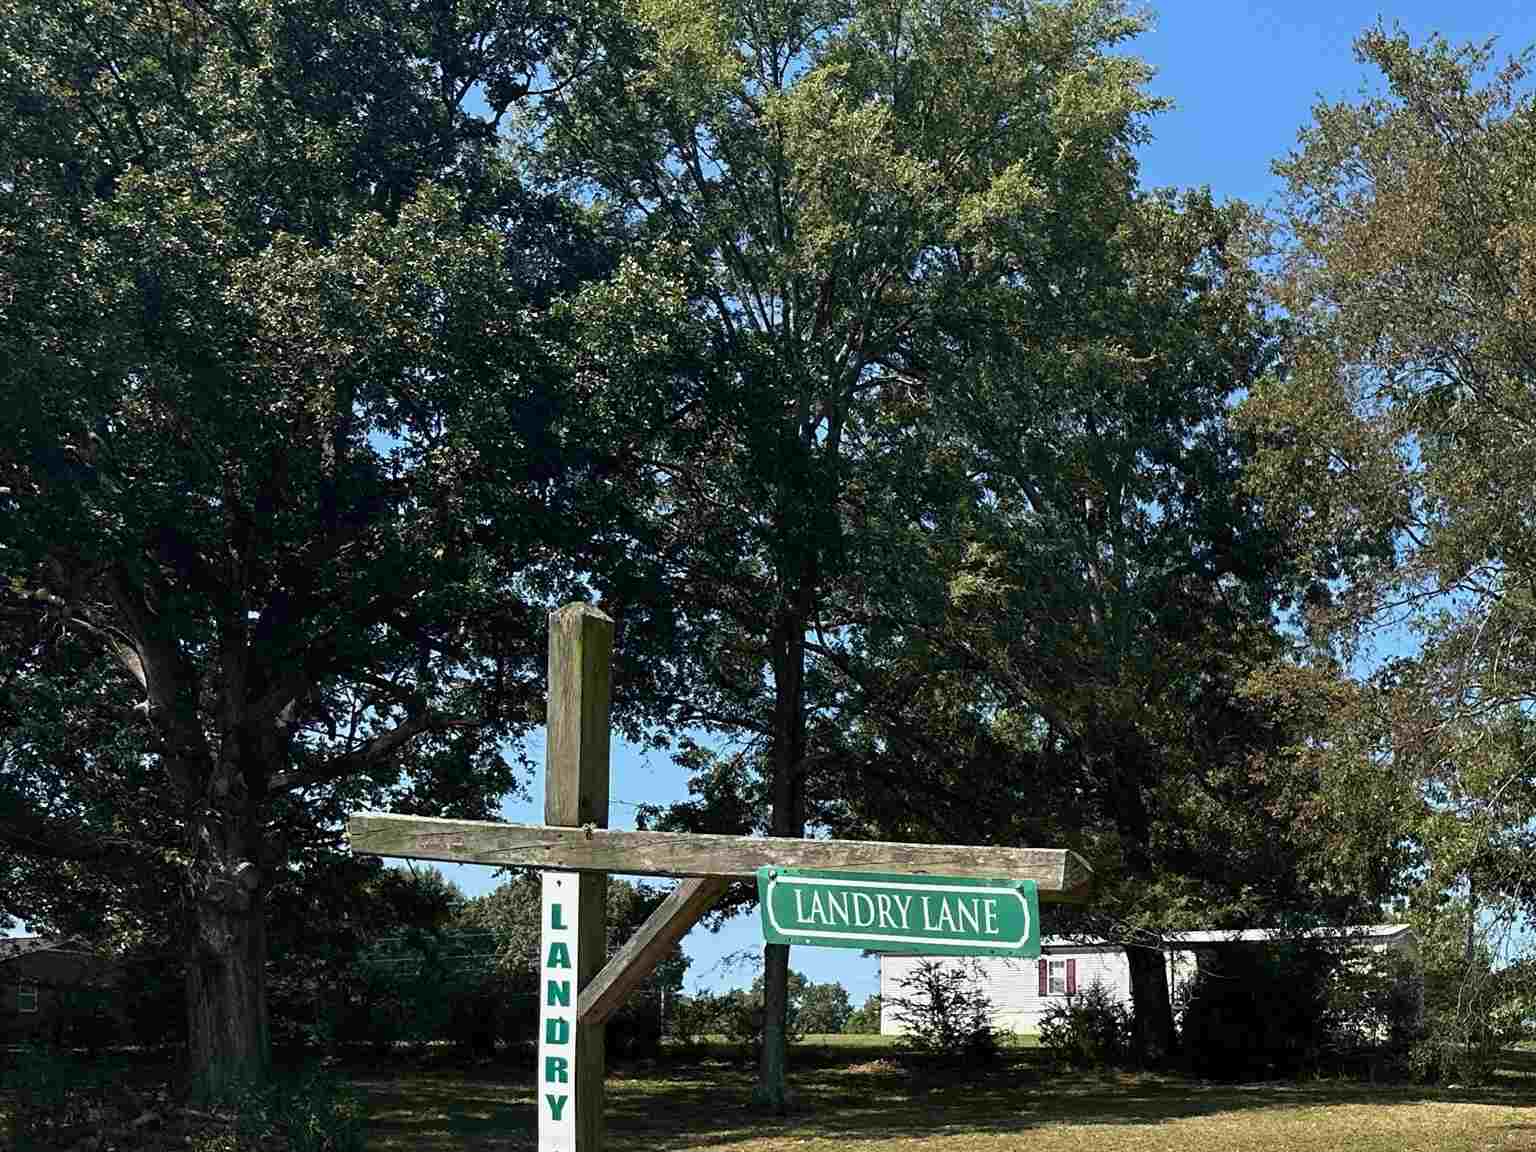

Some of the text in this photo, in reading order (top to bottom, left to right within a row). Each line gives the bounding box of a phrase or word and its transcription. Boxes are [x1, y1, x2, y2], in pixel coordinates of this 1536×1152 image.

[794, 889, 999, 934] LANDRY LANE
[545, 903, 572, 1121] LANDRY
